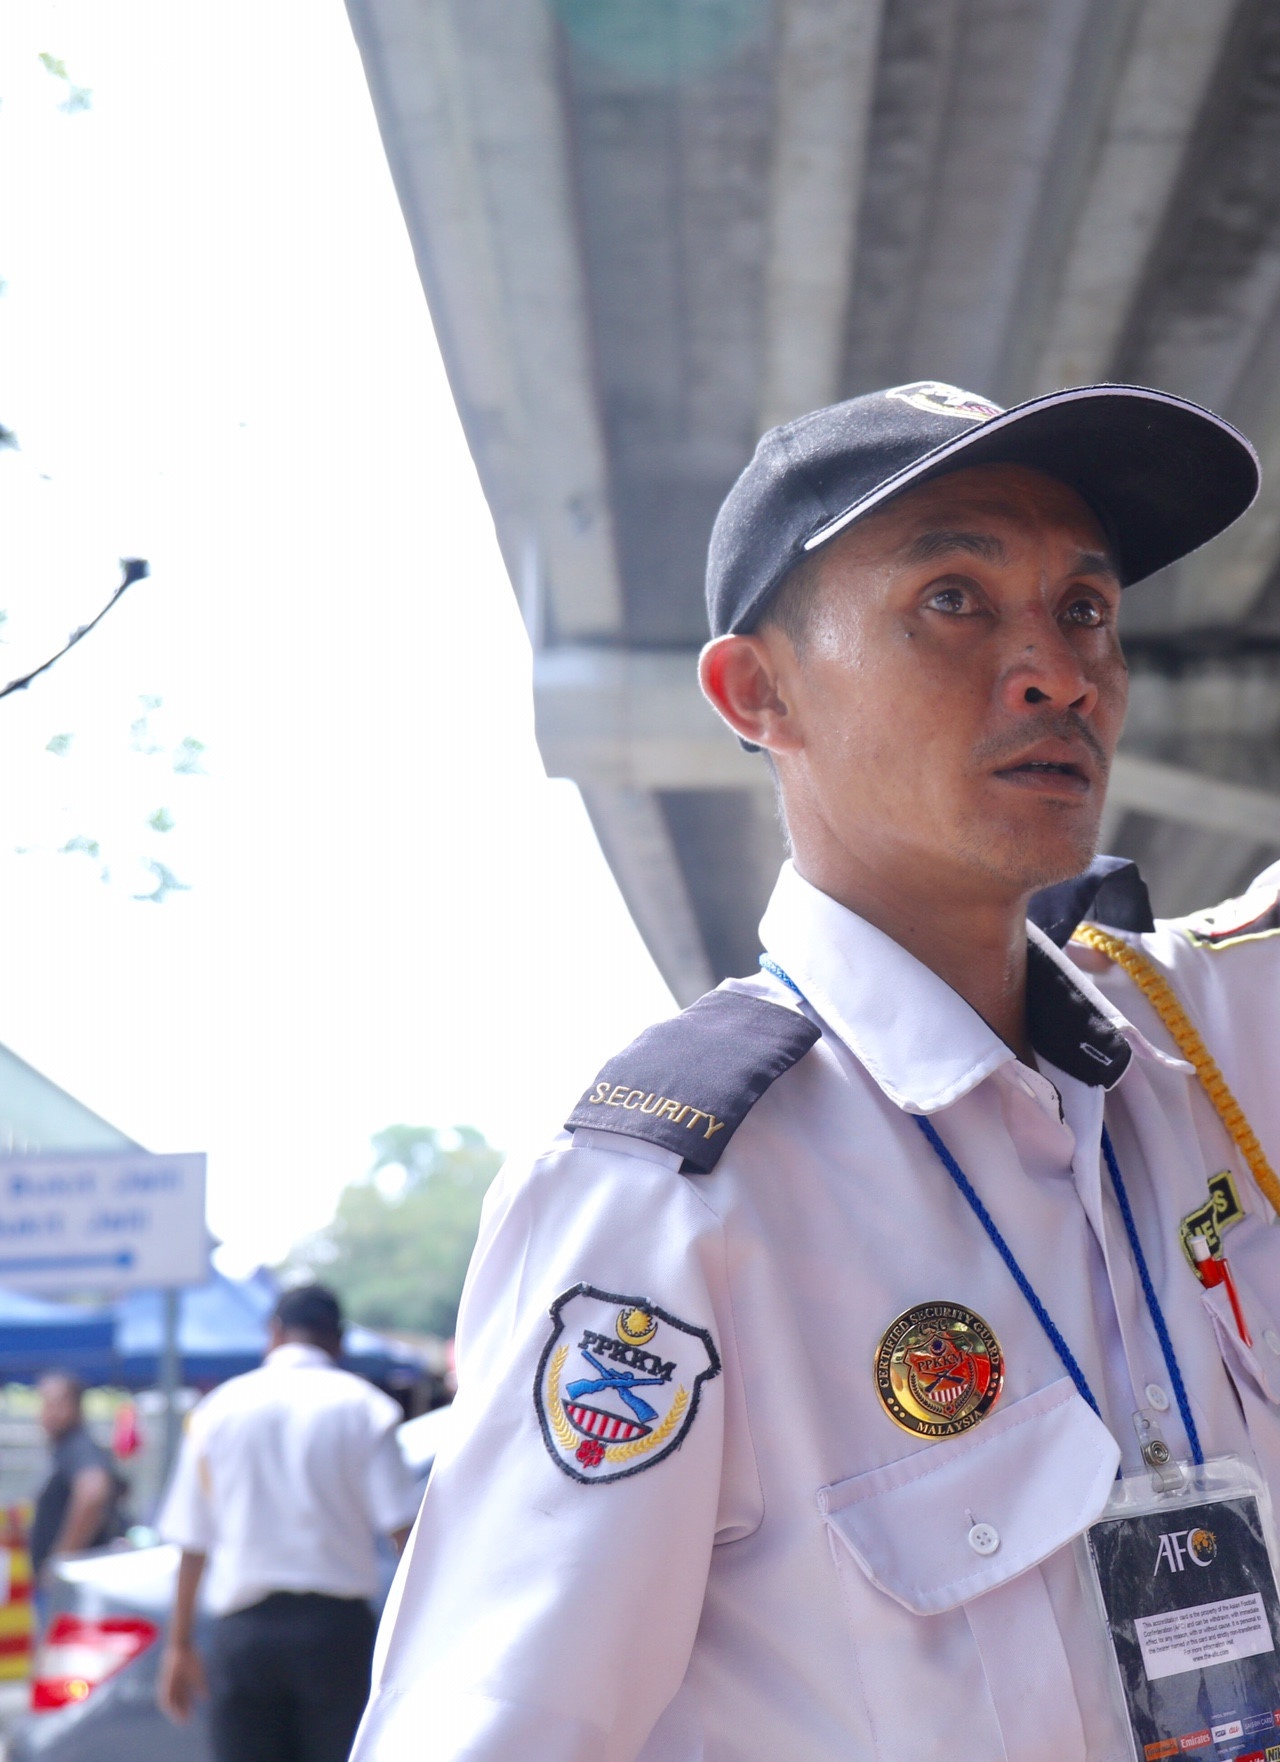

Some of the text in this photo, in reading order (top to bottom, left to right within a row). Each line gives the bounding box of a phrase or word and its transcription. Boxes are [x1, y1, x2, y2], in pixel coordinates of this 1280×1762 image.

[589, 1082, 725, 1139] SECURITY
[577, 1330, 677, 1382] PPKKM
[879, 1306, 1001, 1389] CERTIFIED SECURITY GUARD
[916, 1352, 965, 1372] PPKKM
[916, 1411, 983, 1435] MALAYSIA
[1153, 1527, 1217, 1577] AFC
[1180, 1733, 1211, 1750] Emirates
